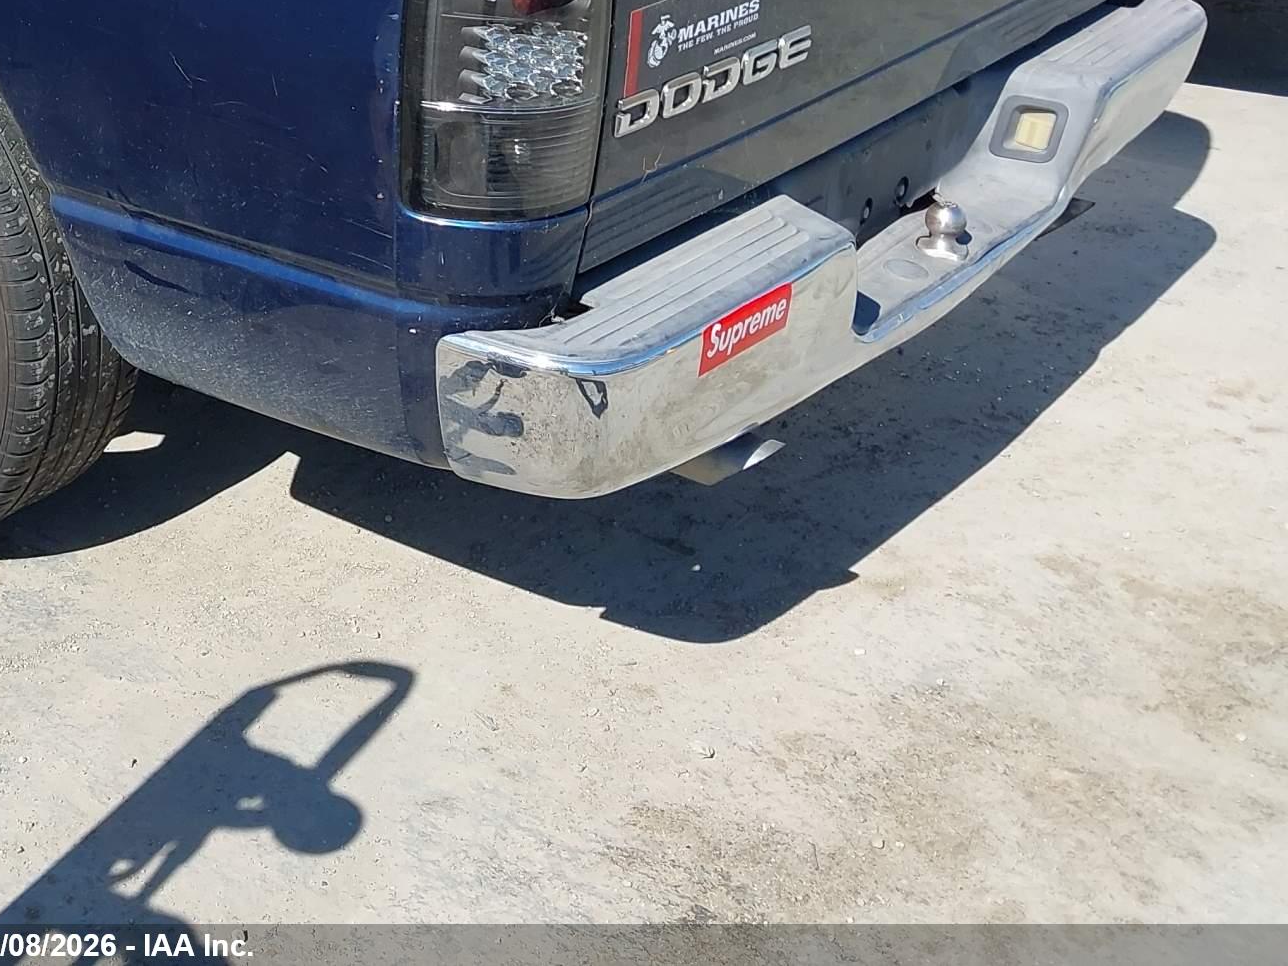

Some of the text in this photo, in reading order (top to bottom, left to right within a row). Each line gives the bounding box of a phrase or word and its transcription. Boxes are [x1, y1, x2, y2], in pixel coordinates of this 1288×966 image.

[677, 39, 694, 52] THE
[716, 23, 732, 36] THE
[733, 12, 759, 29] PROUD
[713, 31, 757, 55] MARINES.COM
[613, 25, 812, 138] DODGE
[706, 298, 787, 358] Supreme
